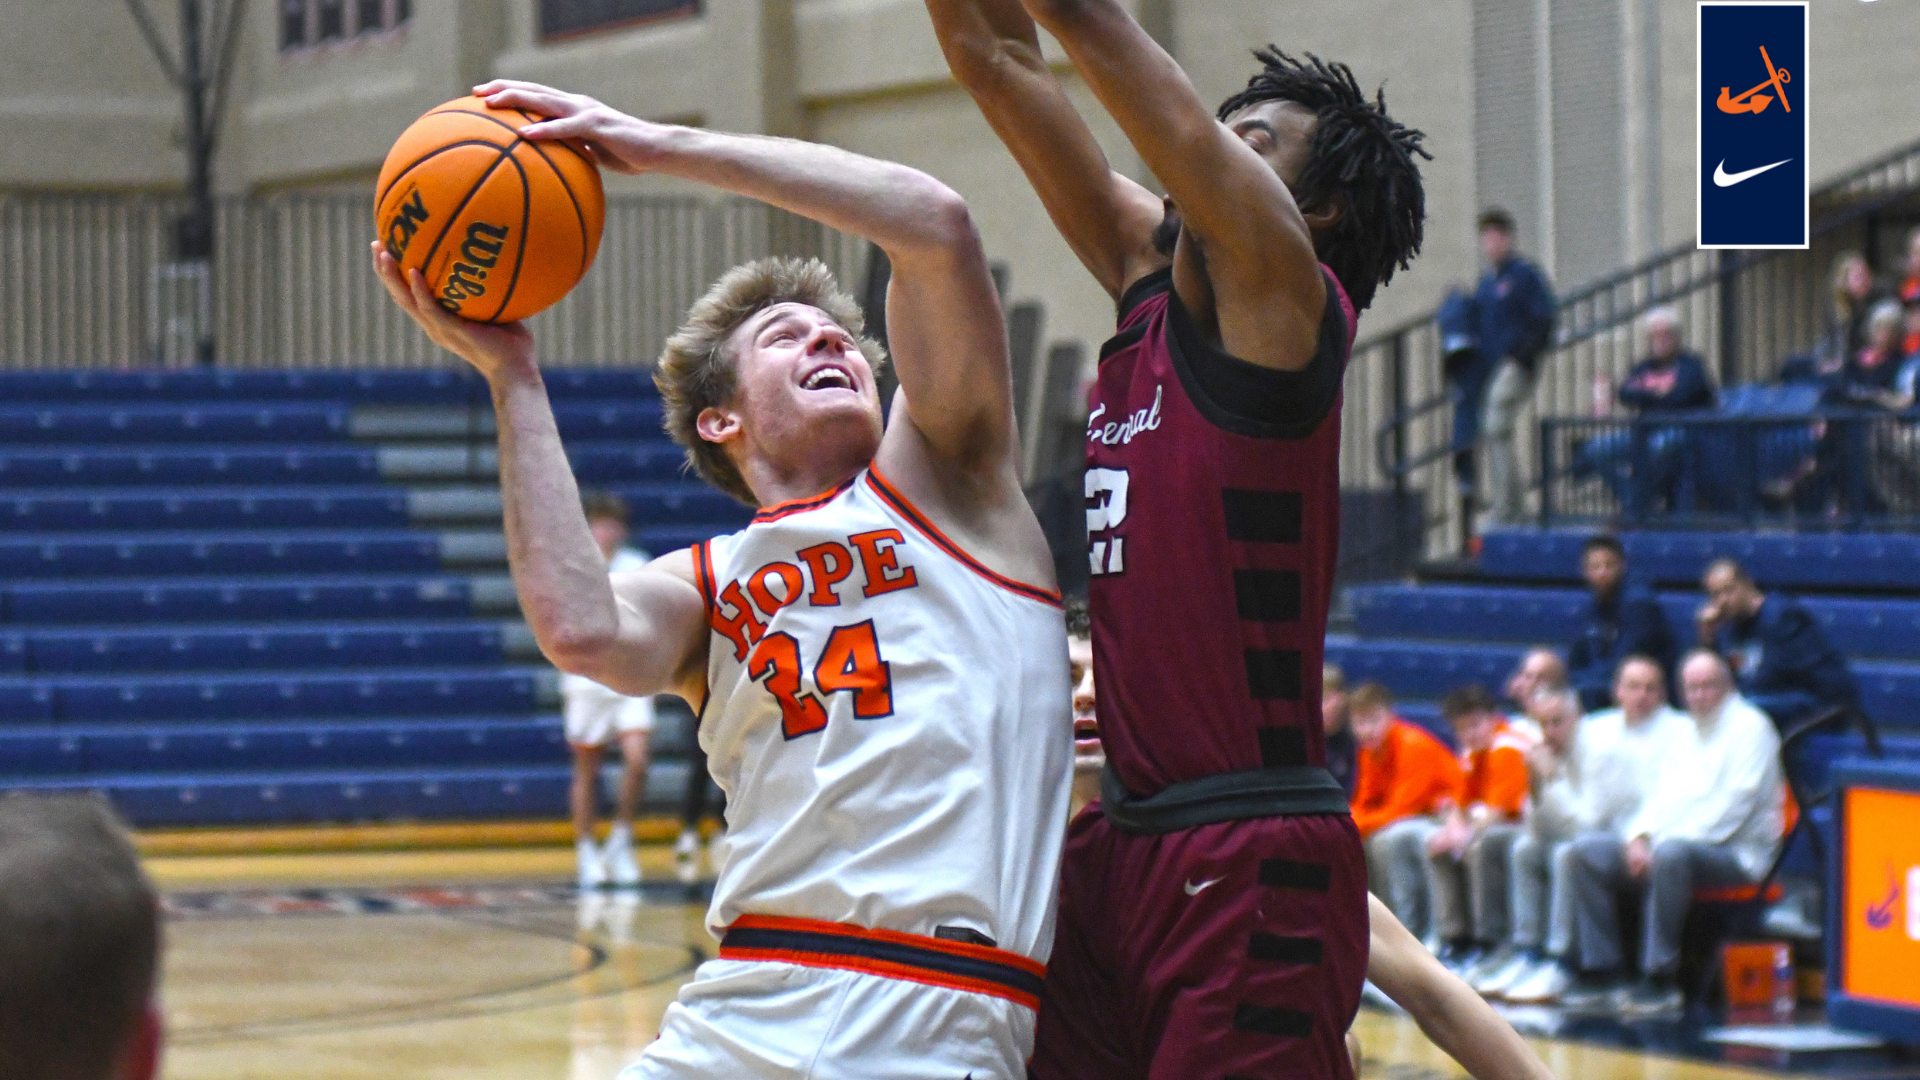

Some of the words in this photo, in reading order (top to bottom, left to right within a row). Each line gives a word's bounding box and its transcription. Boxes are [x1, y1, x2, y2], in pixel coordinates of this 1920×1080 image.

[386, 189, 430, 263] NCA
[437, 221, 509, 313] Wilso
[1086, 384, 1162, 445] Cenral
[712, 528, 919, 664] HOPE
[748, 617, 895, 742] 24
